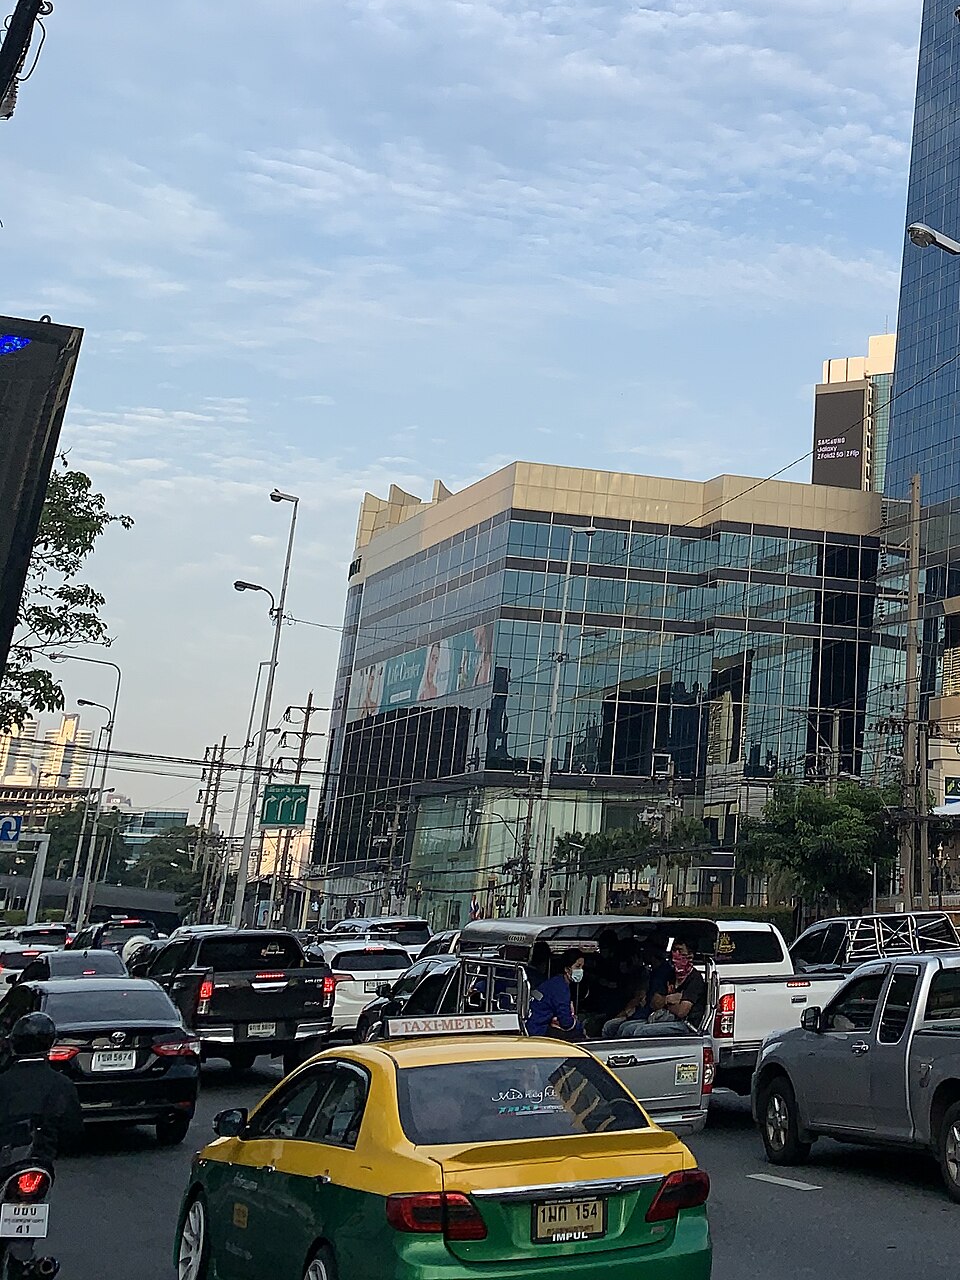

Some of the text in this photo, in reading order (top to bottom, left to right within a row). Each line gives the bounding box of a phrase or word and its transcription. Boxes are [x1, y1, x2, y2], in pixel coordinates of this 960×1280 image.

[947, 722, 960, 733] LH
[402, 1017, 495, 1033] TAXI-METER
[576, 1203, 597, 1220] 154
[552, 1231, 588, 1242] IMPUL
